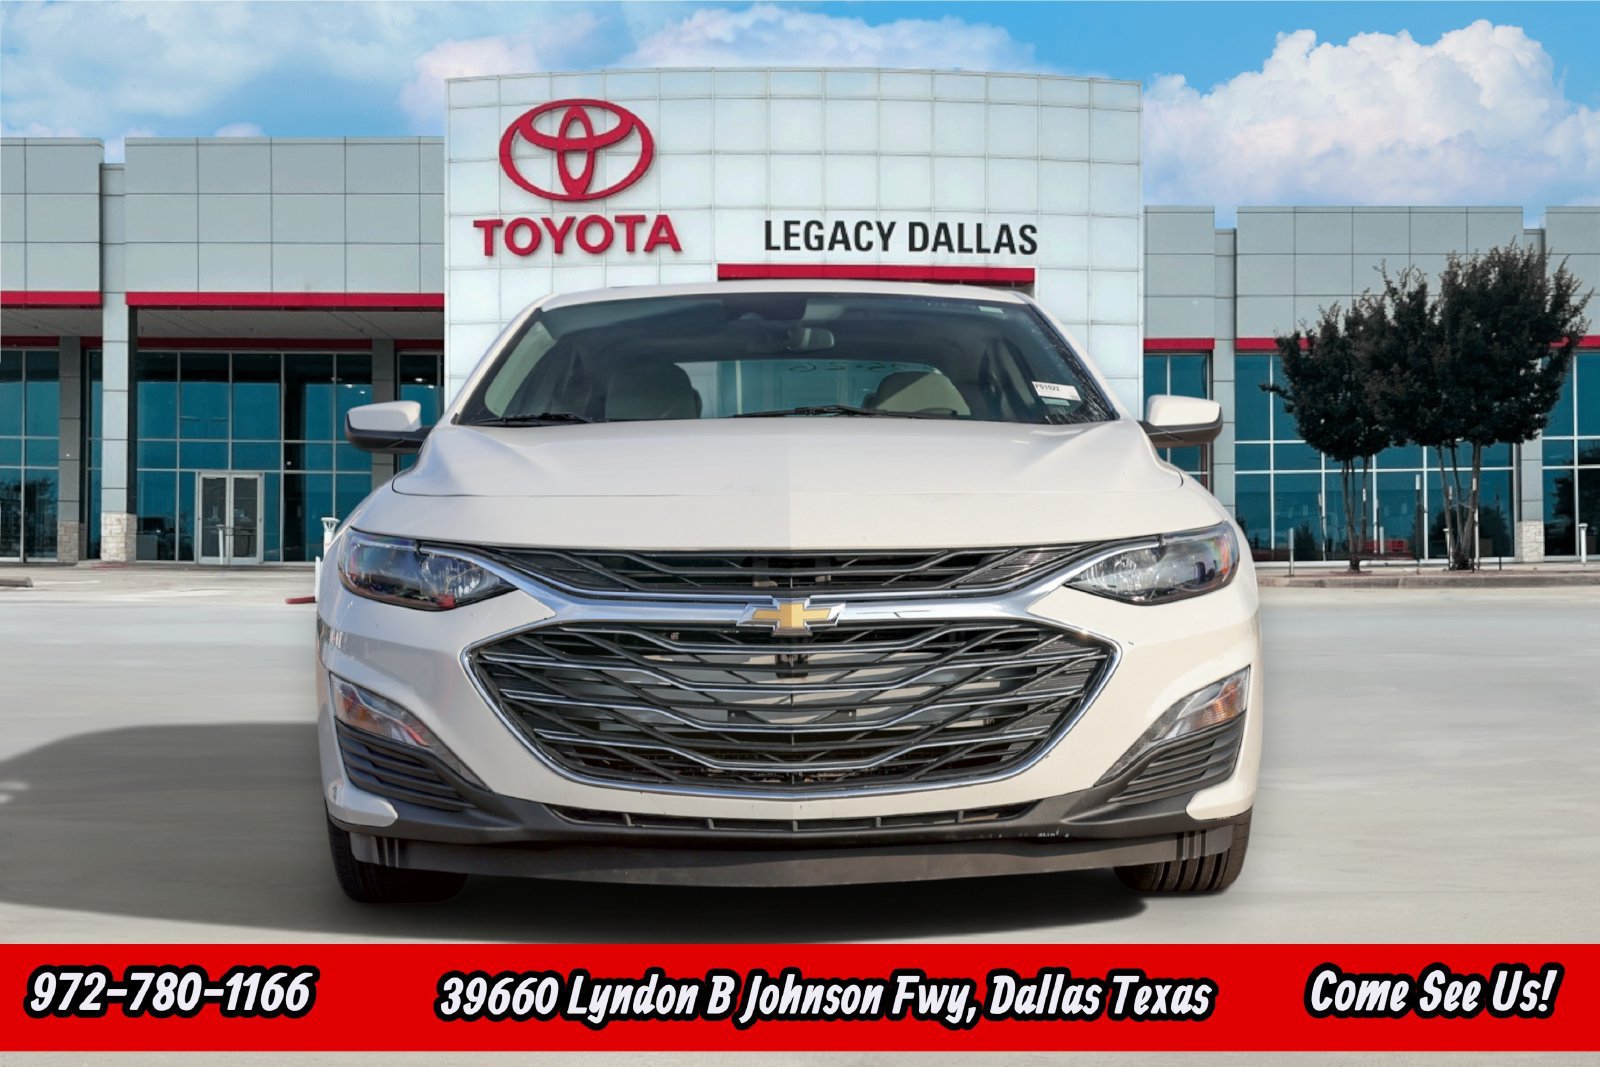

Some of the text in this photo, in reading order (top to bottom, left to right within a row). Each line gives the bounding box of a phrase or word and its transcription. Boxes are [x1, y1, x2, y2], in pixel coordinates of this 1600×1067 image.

[474, 214, 682, 257] TOYOTA
[765, 220, 1038, 255] LEGACY DALLAS
